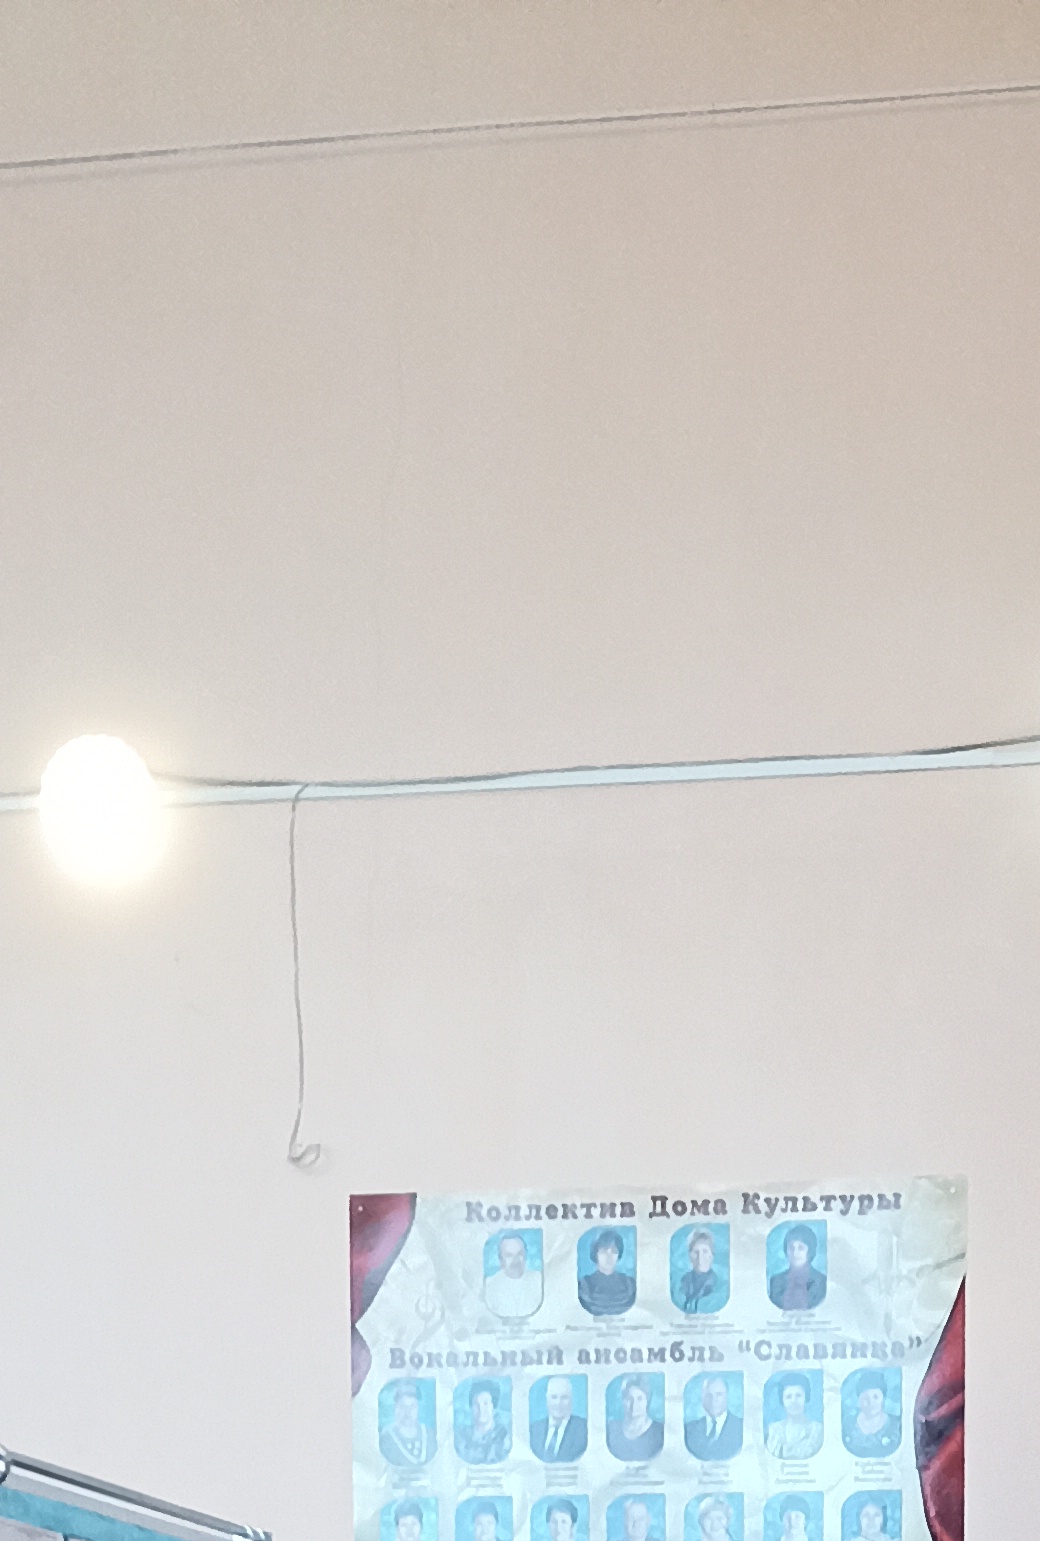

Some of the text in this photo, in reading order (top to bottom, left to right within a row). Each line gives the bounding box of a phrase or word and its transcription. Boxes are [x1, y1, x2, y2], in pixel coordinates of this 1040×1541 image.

[465, 1192, 902, 1223] Коллектив Дома Культуры
[389, 1345, 564, 1369] Вокальный
[577, 1340, 724, 1365] ансамбль
